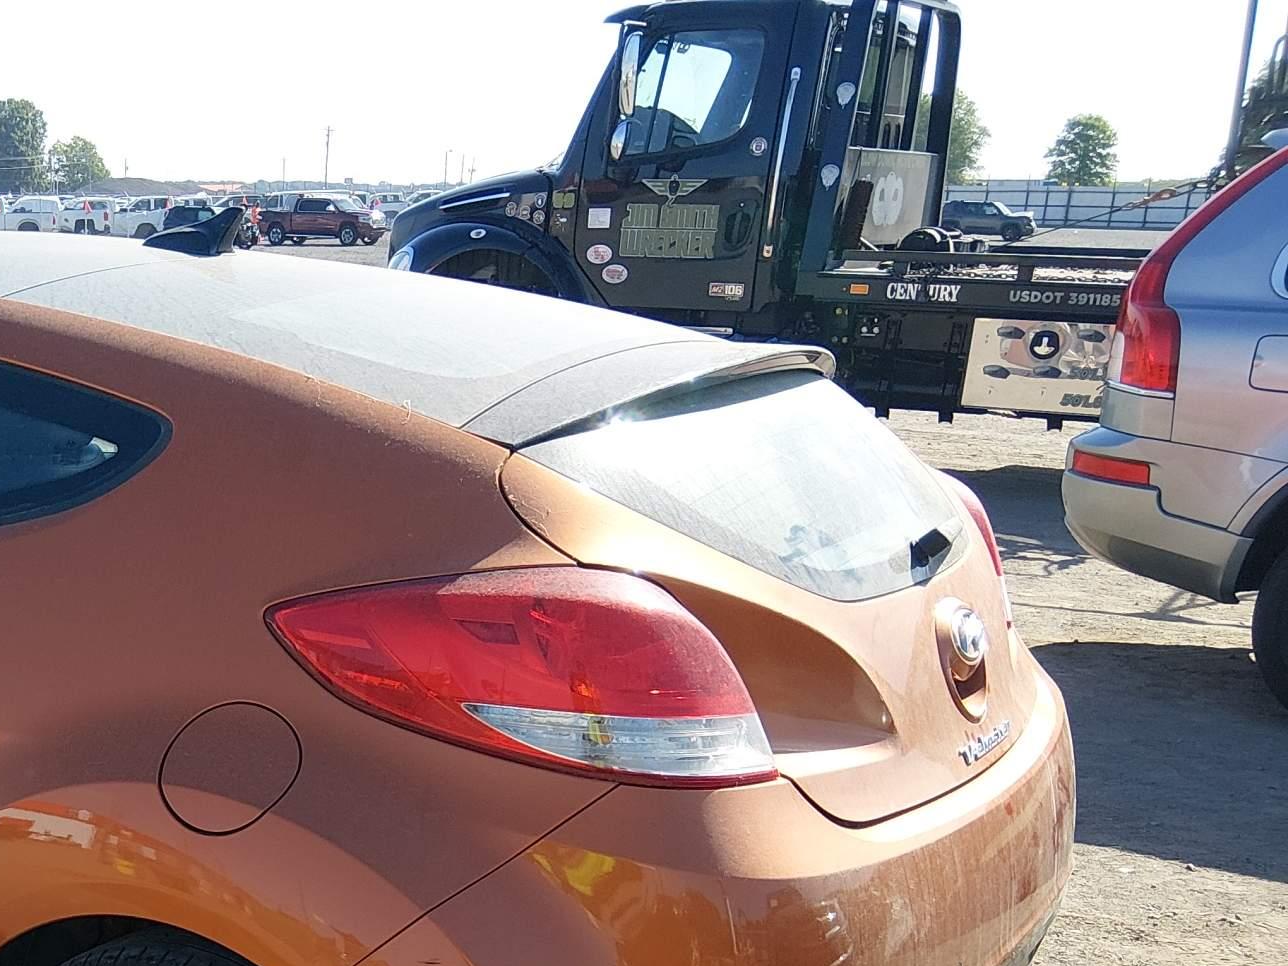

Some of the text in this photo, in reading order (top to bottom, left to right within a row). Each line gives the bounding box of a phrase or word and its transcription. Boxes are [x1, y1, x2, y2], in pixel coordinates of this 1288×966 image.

[622, 203, 659, 229] JIM
[619, 228, 717, 259] WRECKER
[724, 284, 743, 296] 106
[886, 282, 961, 303] CENURY
[1009, 290, 1064, 305] USDOT
